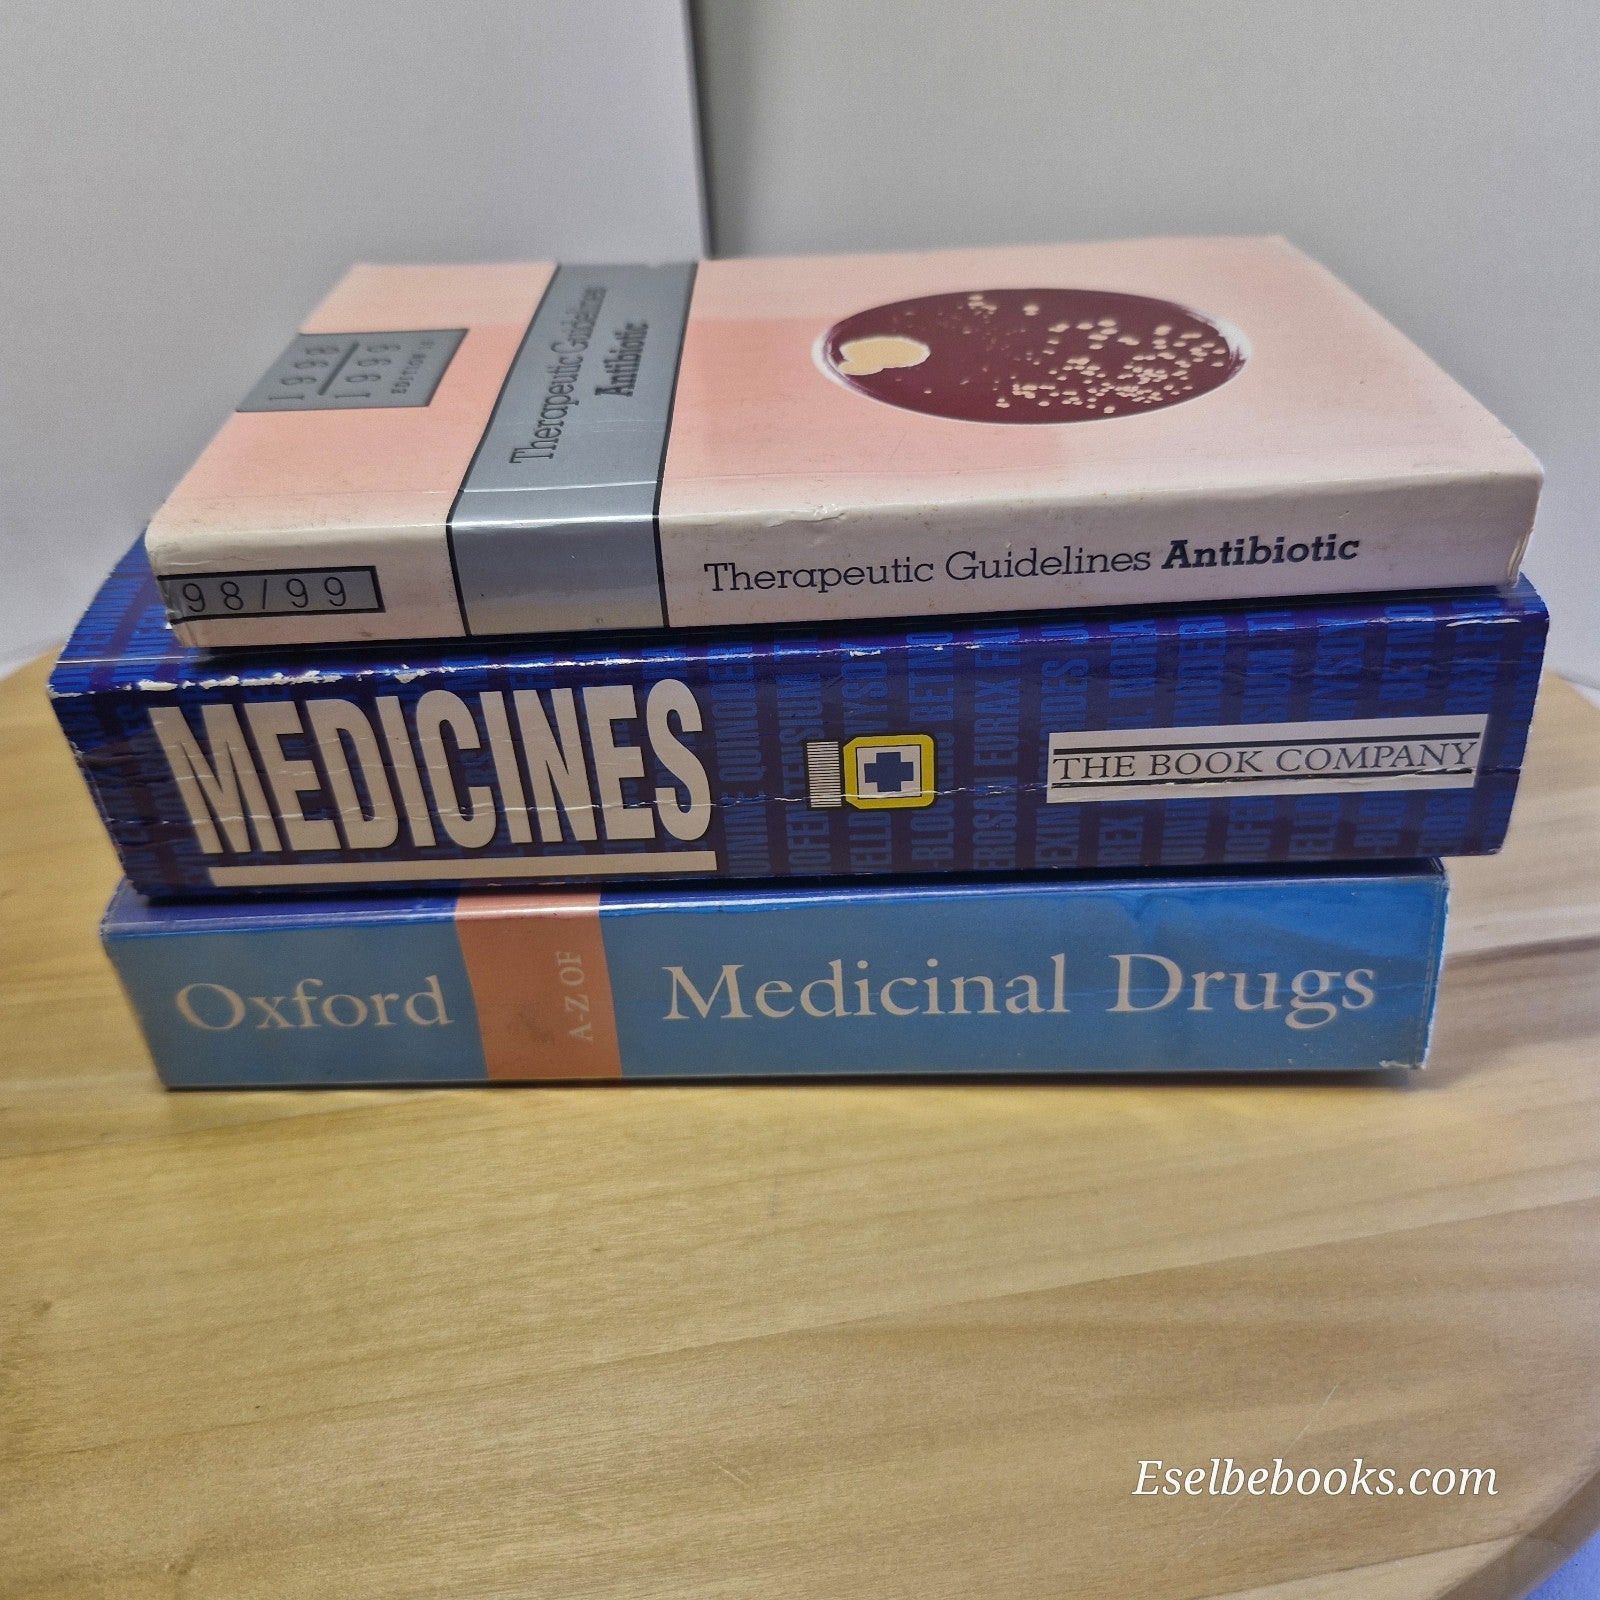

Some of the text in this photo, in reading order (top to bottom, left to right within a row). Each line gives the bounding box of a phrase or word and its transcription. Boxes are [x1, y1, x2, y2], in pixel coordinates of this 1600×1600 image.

[334, 342, 401, 399] 1999
[509, 286, 607, 464] Therapeutic Guidelines
[595, 319, 649, 397] Antibiotic
[182, 575, 348, 614] 98/99
[704, 533, 1361, 594] Therapeutic Guidelines Antibiotic
[148, 679, 711, 855] MEDICINES
[1053, 741, 1477, 780] THE BOOK COMPANY
[177, 975, 455, 1031] Oxford
[555, 950, 594, 1043] A-Z OF
[661, 952, 1377, 1031] Medicinal Drugs
